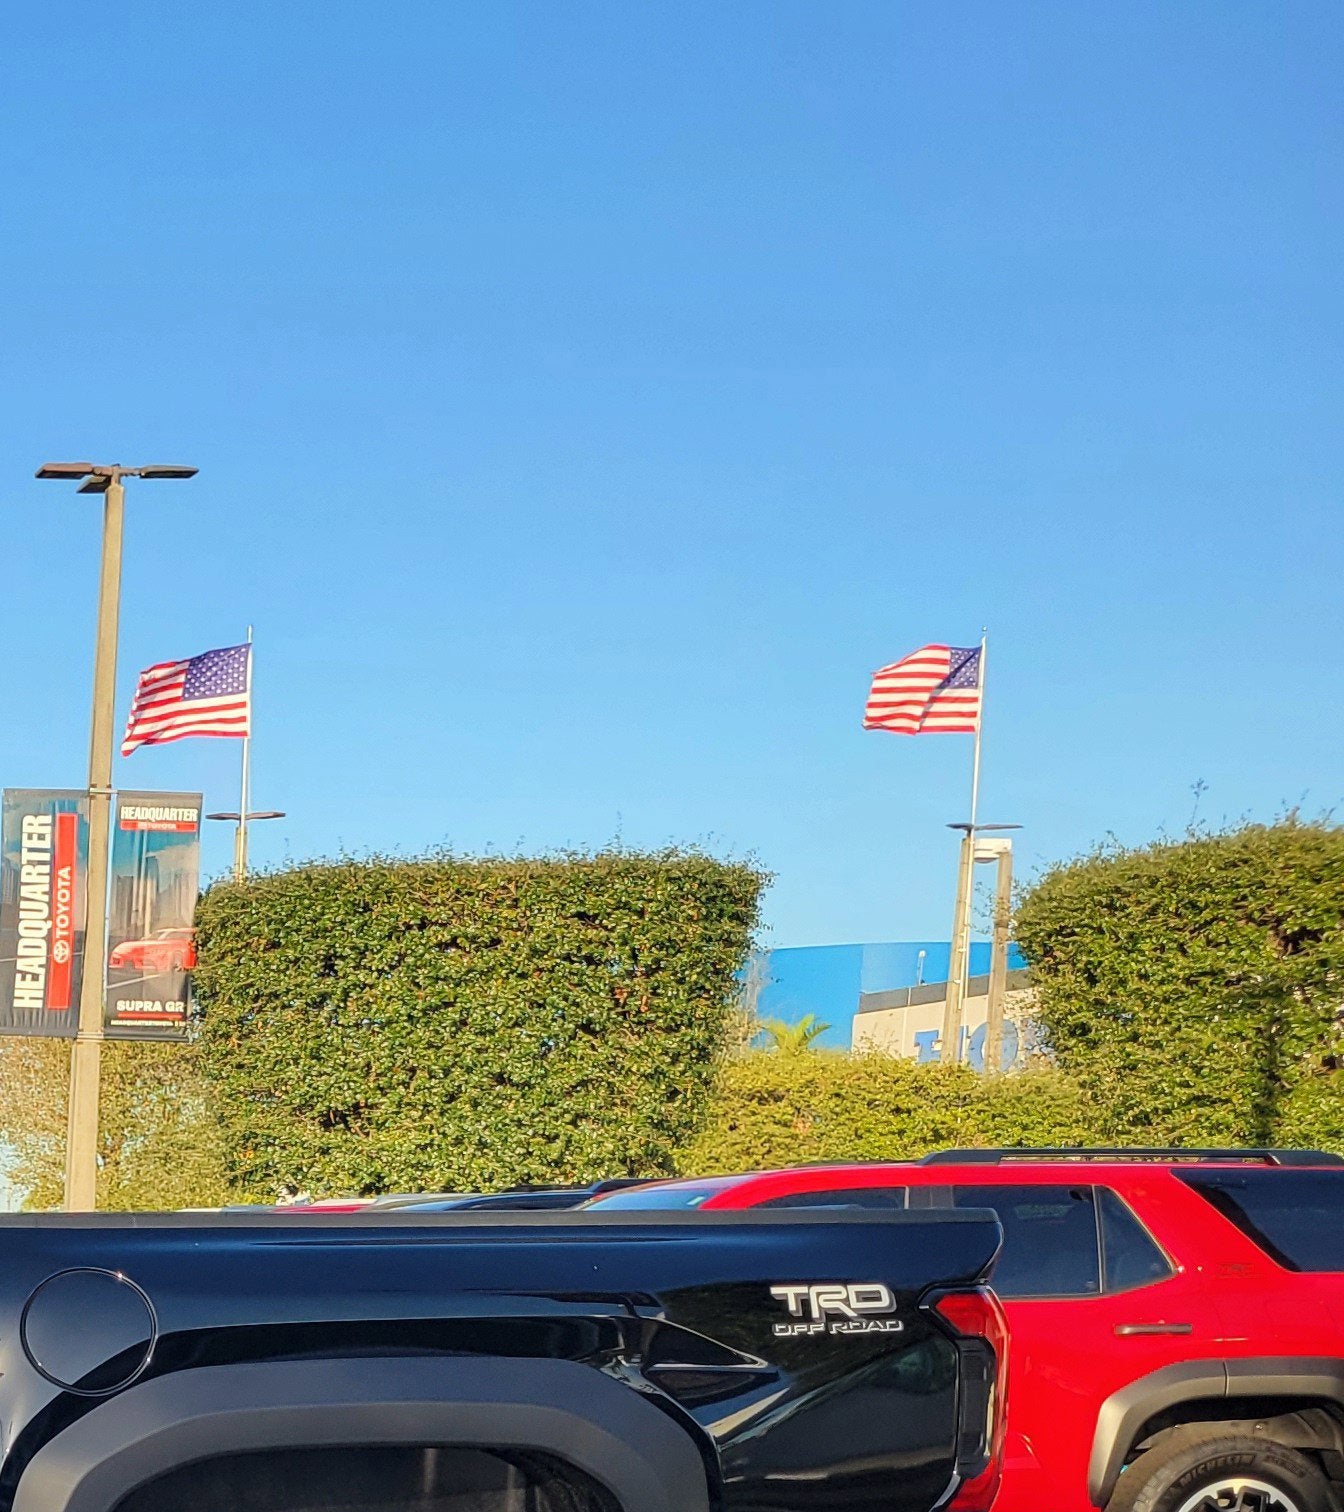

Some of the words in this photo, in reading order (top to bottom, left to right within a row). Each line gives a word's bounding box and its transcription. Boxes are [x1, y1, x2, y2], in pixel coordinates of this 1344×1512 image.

[120, 806, 198, 822] HEADQUARTER
[12, 814, 52, 1008] HEADQUARTER
[56, 866, 72, 938] TOYOTA
[116, 1000, 163, 1012] SUPRA
[165, 1001, 184, 1012] GR
[769, 1284, 897, 1322] TRD
[772, 1323, 825, 1336] OFF
[830, 1320, 904, 1335] ROAD
